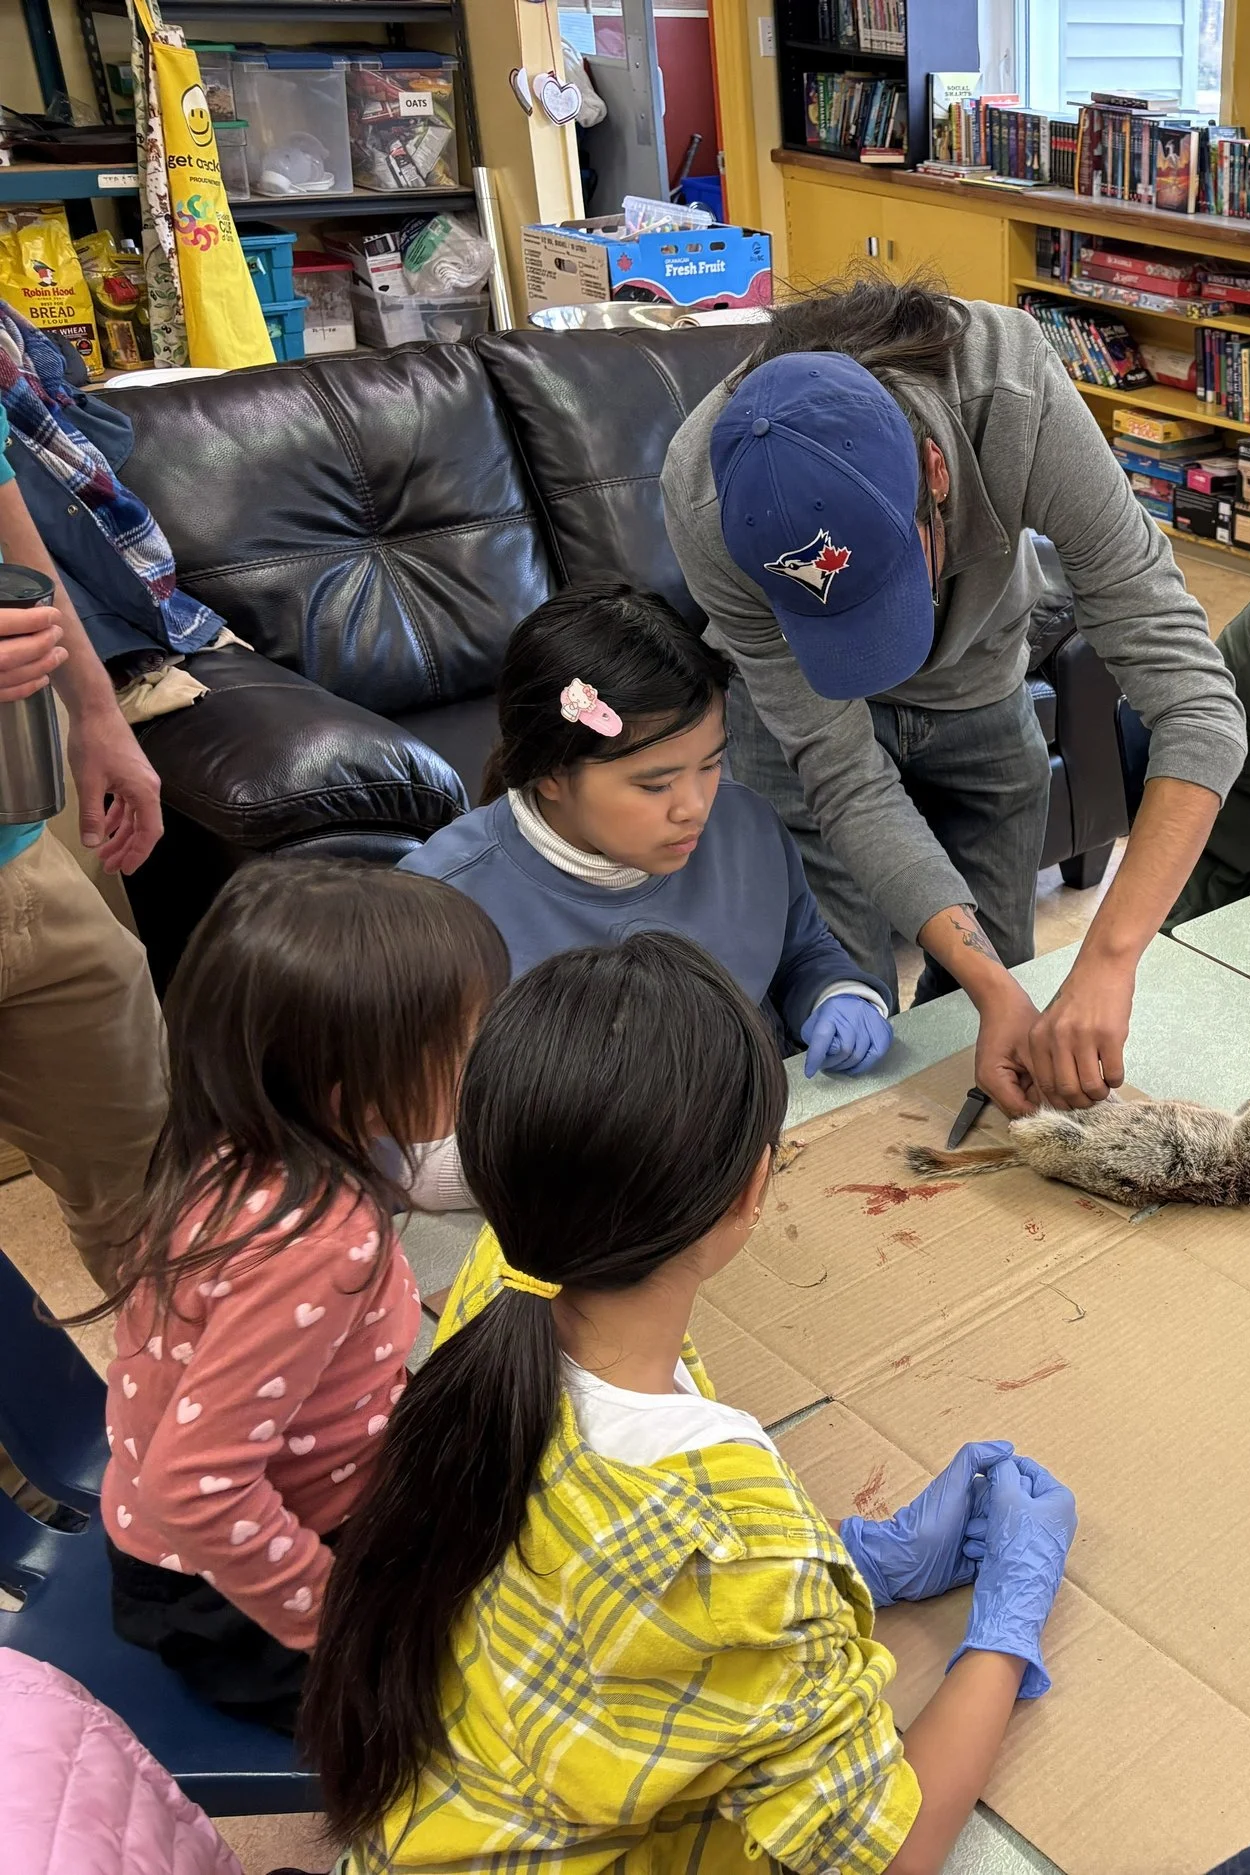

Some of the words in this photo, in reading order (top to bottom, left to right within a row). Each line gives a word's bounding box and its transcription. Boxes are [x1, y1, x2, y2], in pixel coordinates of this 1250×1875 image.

[405, 99, 428, 108] OATS
[168, 154, 193, 169] get
[665, 262, 697, 277] Fresh
[698, 260, 726, 274] Fruit
[21, 287, 51, 298] Robin
[29, 305, 76, 318] BREAD
[59, 326, 87, 336] WHEAT
